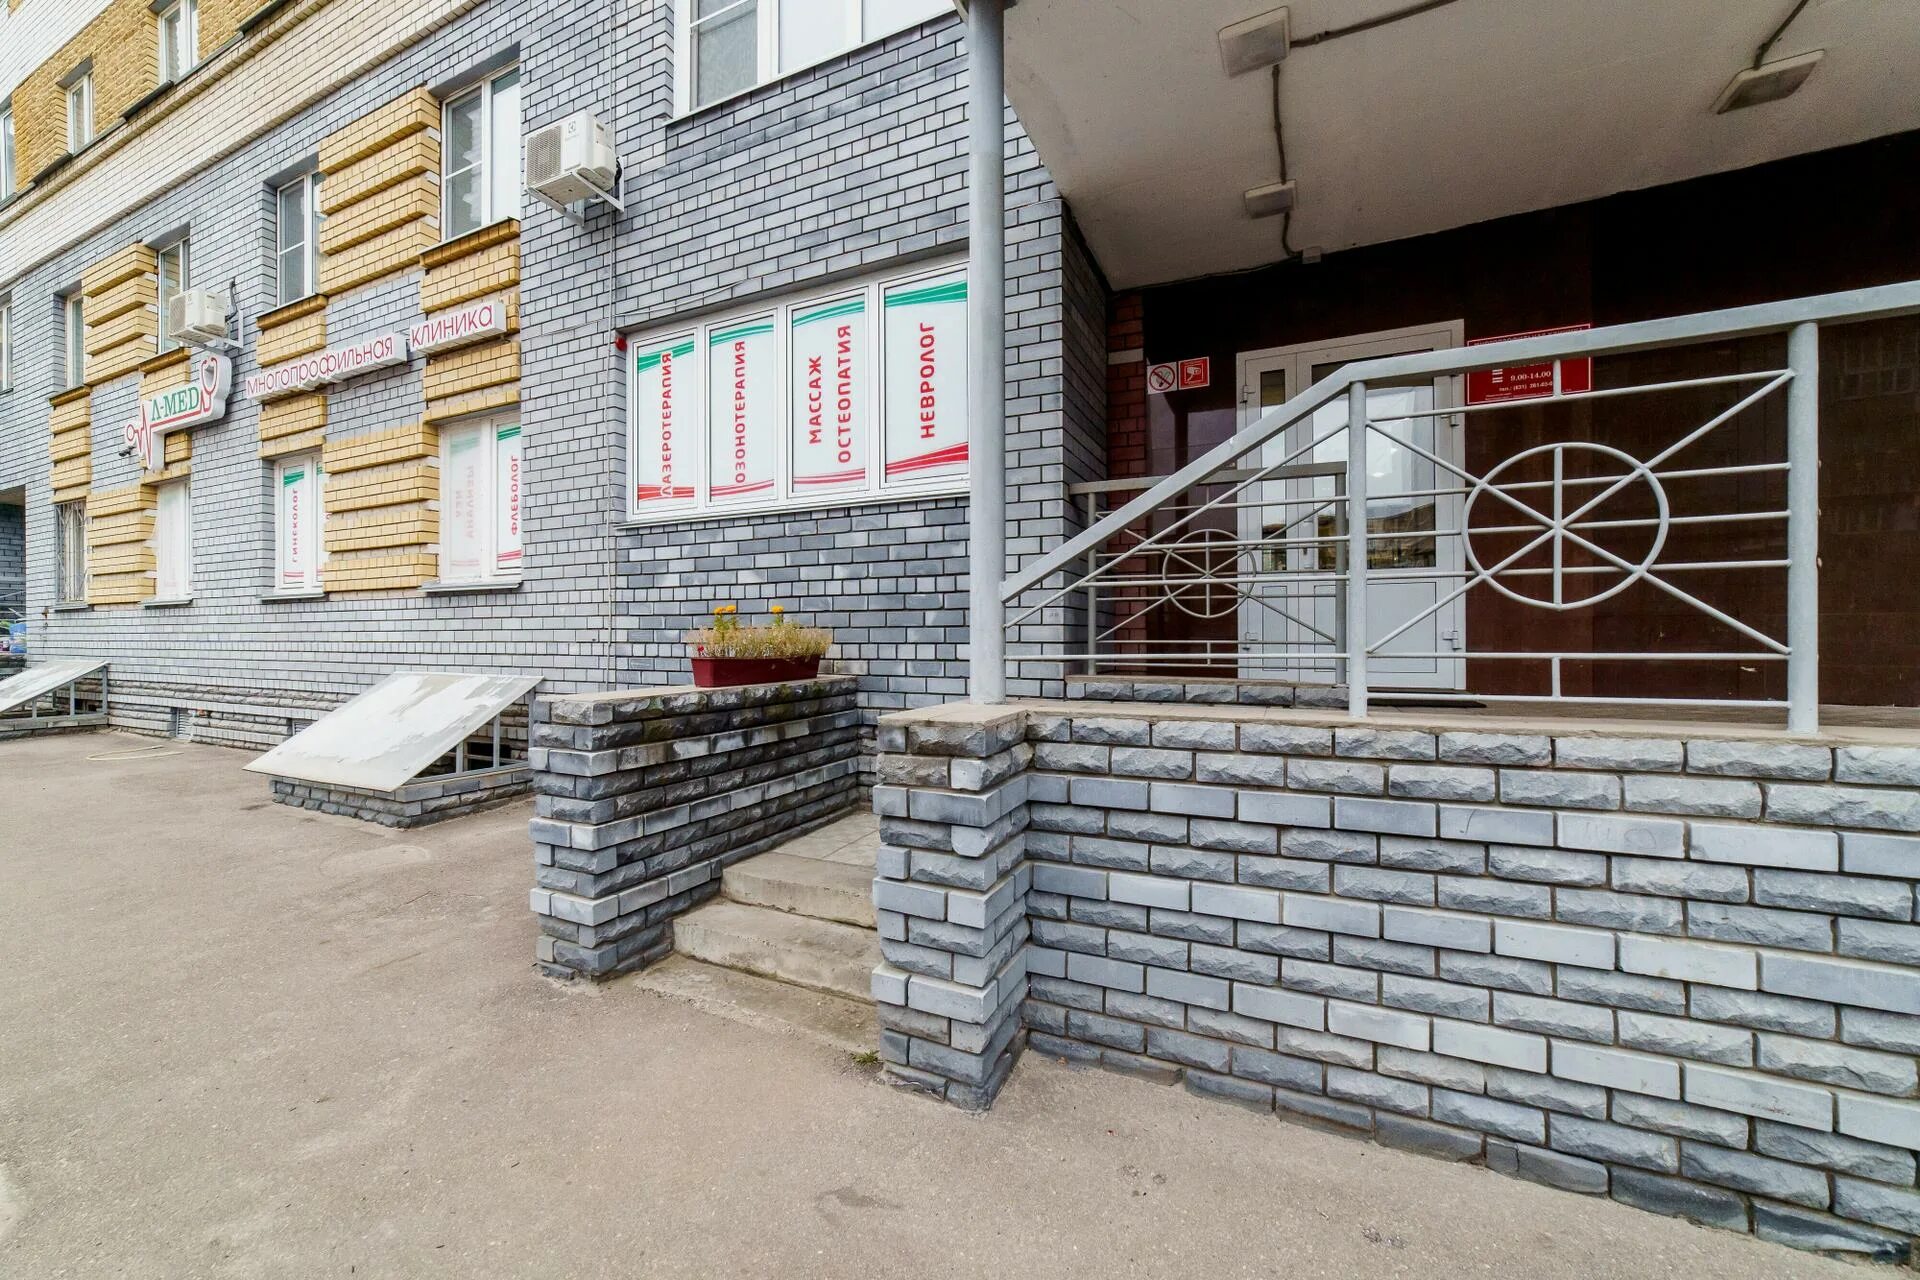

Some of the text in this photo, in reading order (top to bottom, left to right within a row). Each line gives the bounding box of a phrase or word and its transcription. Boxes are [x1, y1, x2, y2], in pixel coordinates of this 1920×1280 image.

[661, 352, 672, 496] ЛАЗЕРОТЕРАПИЯ
[734, 340, 745, 483] ОЗОНОТЕРАПИЯ
[809, 355, 822, 444] МАССАЖ
[837, 324, 851, 463] ОСТЕОПАТИЯ
[920, 322, 935, 439] НЕВРОЛОГ
[1510, 371, 1551, 381] 9.00-14.00
[511, 455, 519, 535] ФЛЕБОЛОГ
